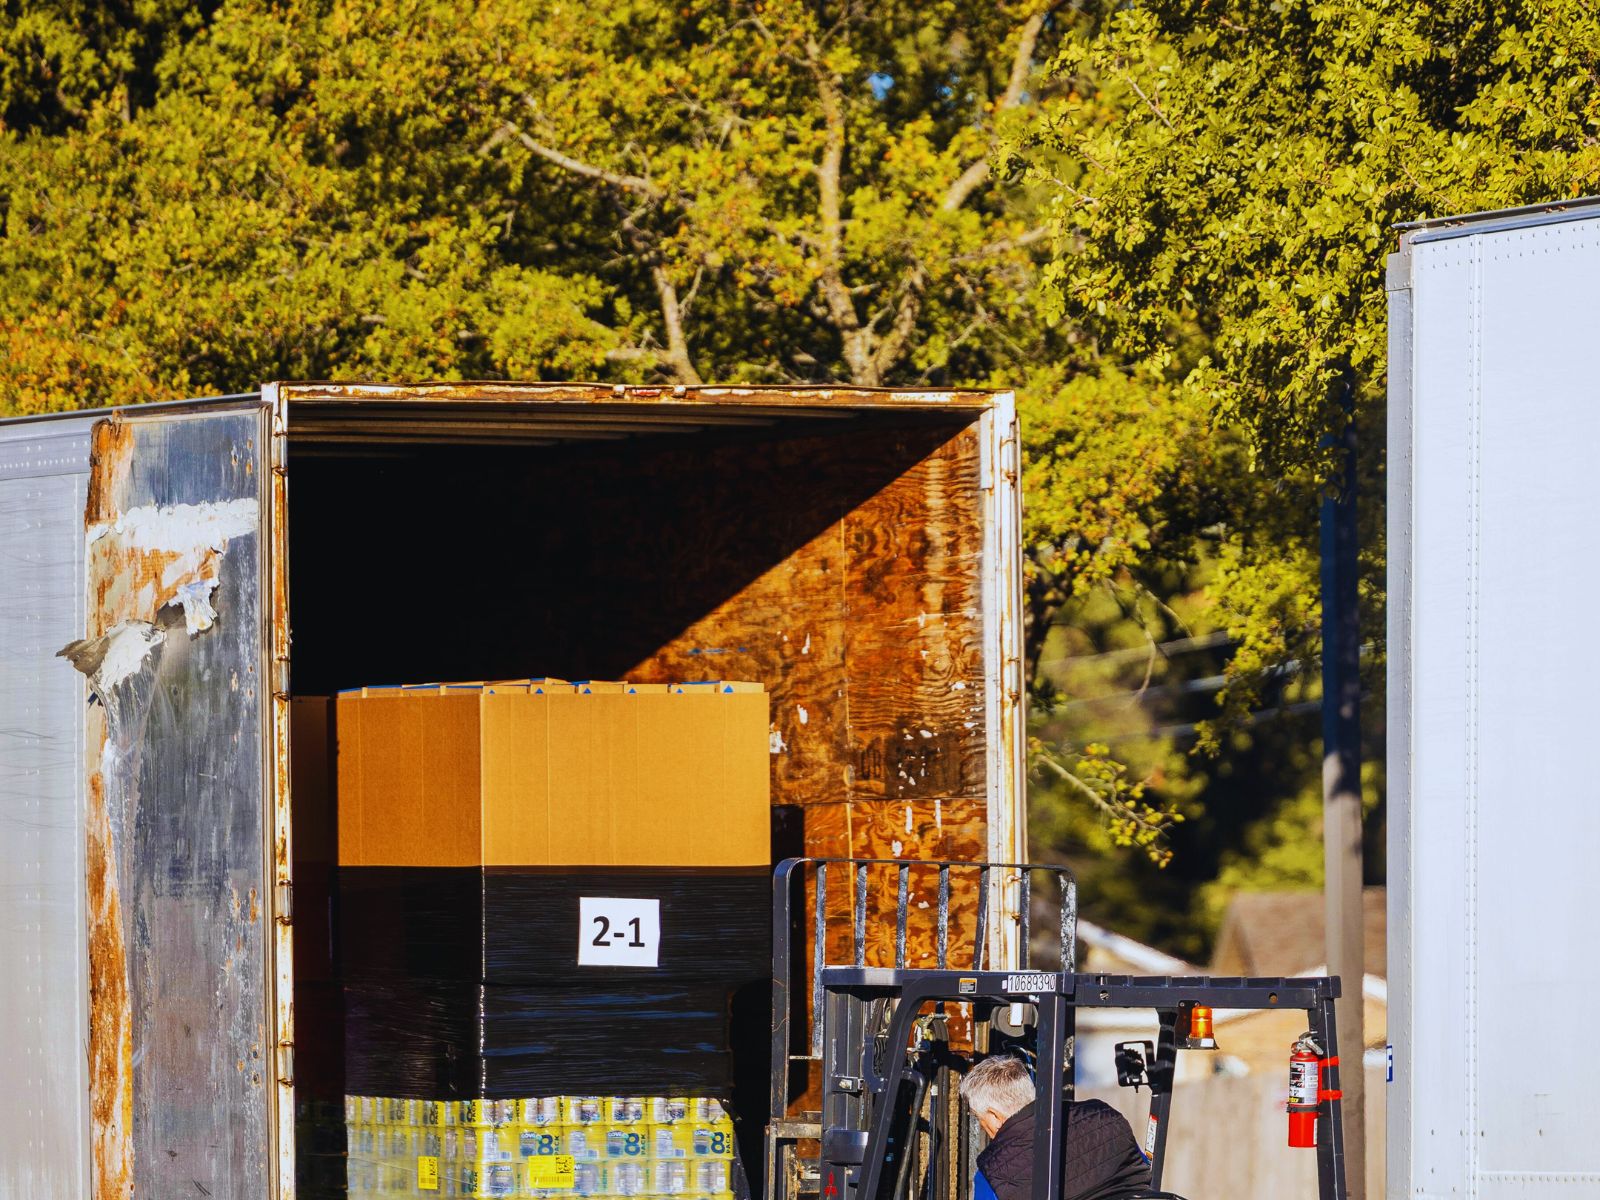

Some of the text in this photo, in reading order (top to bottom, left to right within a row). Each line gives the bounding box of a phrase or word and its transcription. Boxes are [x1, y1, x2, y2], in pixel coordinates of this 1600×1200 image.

[592, 915, 645, 948] 2-1
[1009, 974, 1056, 991] 10689390
[537, 1134, 553, 1155] 8
[624, 1132, 641, 1156] 8
[710, 1131, 726, 1154] 8
